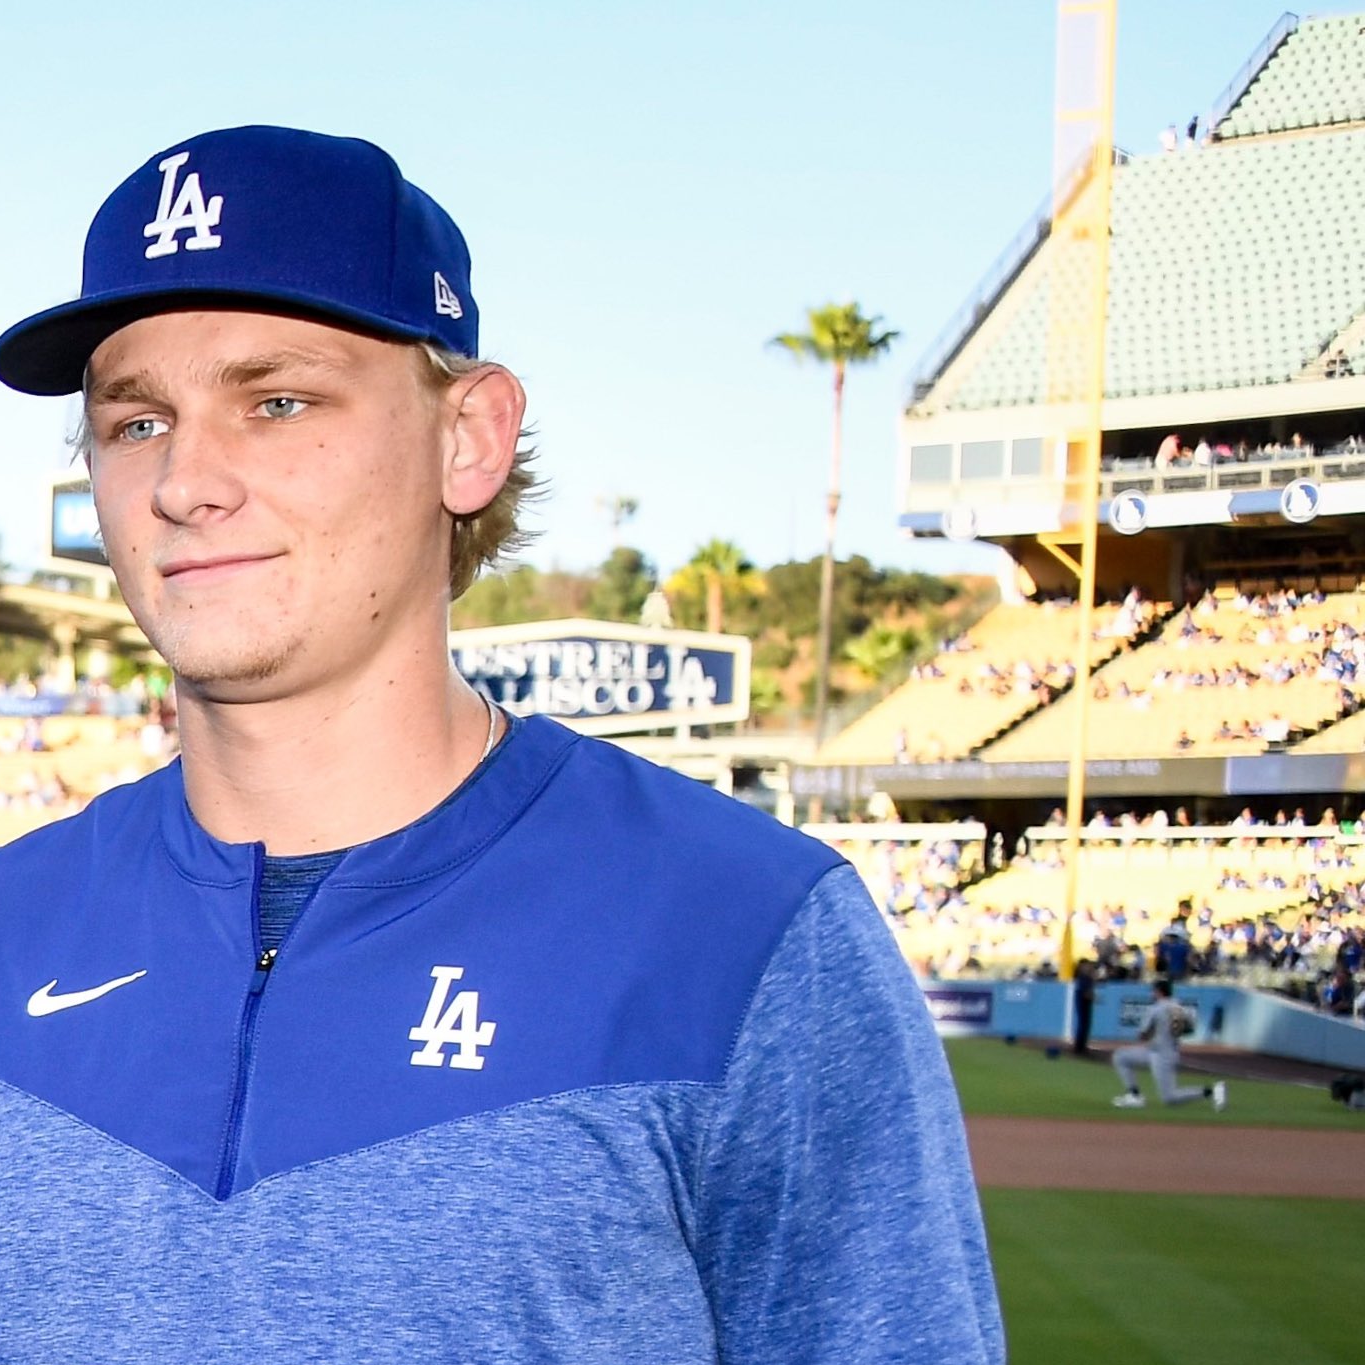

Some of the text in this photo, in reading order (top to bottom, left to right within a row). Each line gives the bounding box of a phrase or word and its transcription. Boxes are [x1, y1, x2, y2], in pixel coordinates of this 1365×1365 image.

[143, 151, 223, 259] LA
[460, 641, 666, 680] ESTREL
[472, 676, 656, 715] ALISCO
[408, 965, 497, 1070] LA
